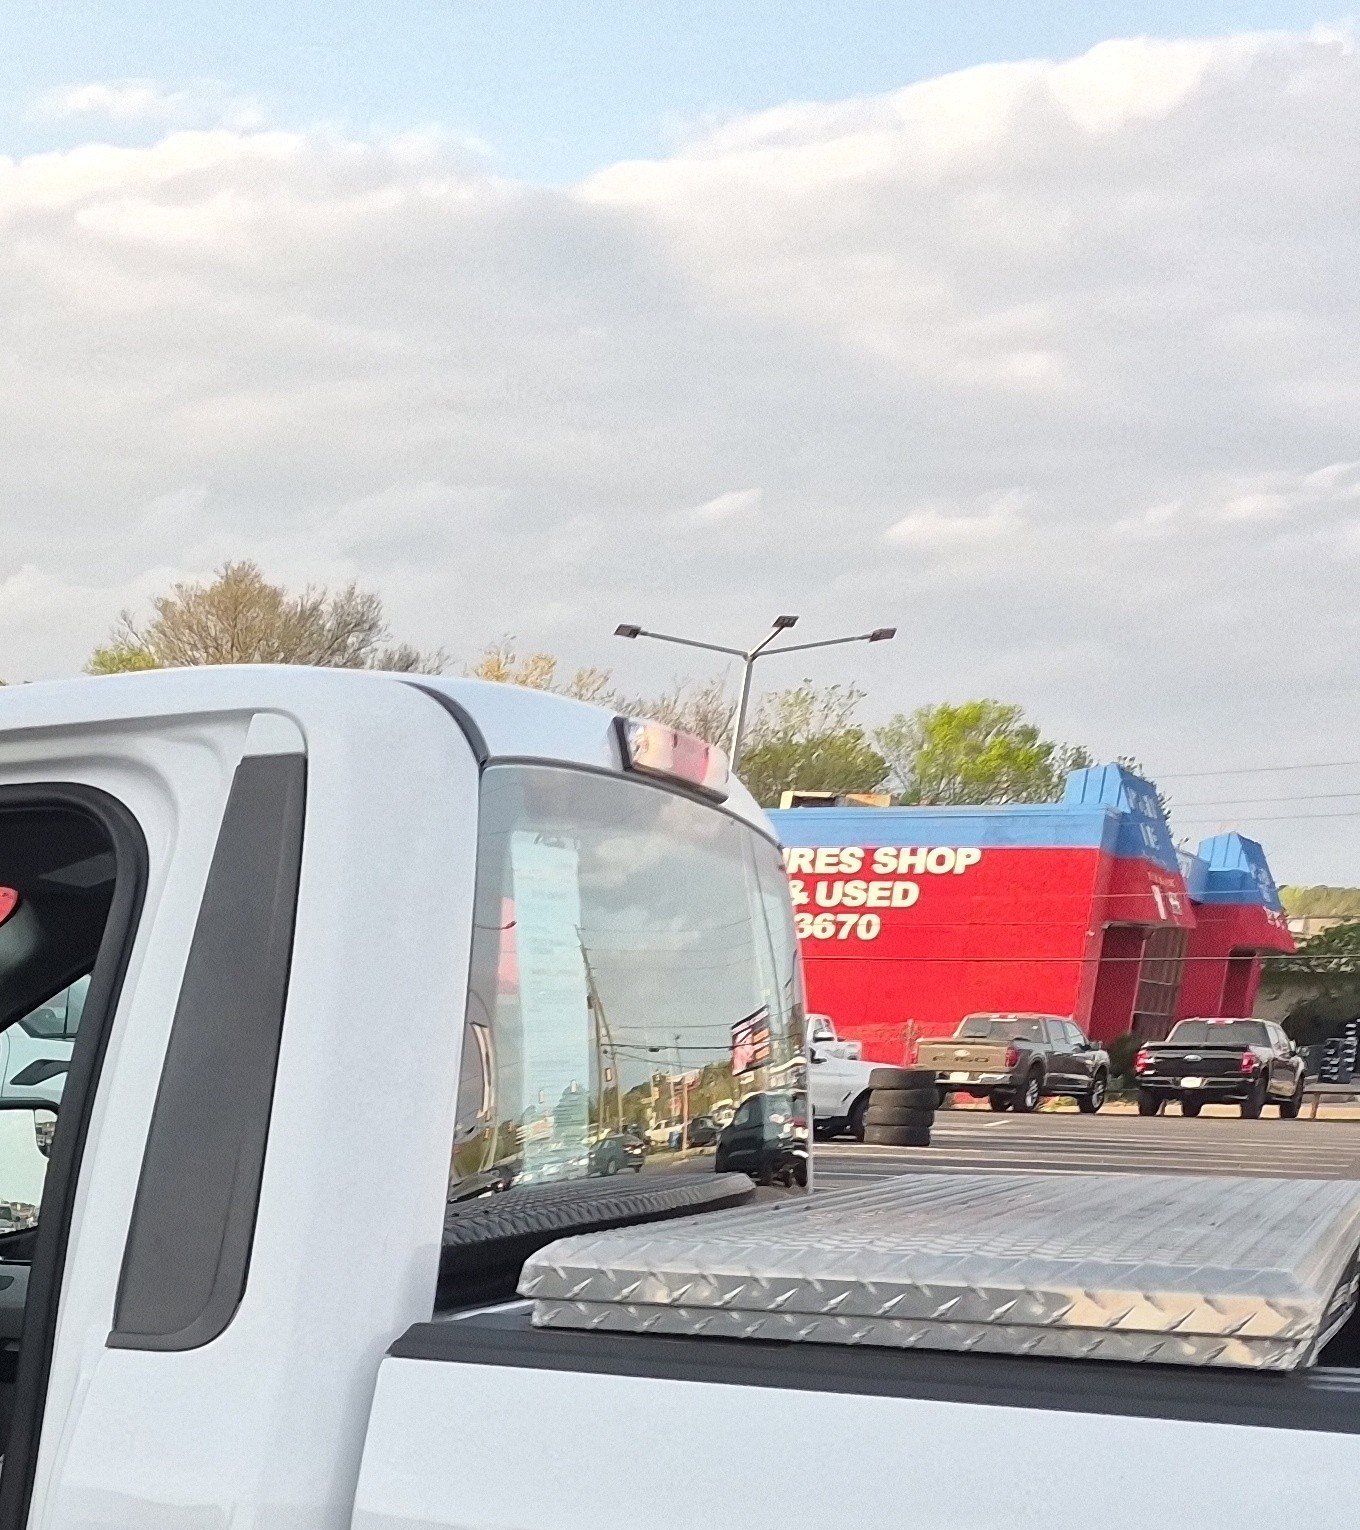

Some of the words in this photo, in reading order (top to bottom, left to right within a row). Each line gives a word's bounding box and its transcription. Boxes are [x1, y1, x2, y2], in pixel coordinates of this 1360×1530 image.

[871, 846, 982, 874] SHOP
[815, 880, 920, 908] USED
[794, 912, 881, 940] 3670
